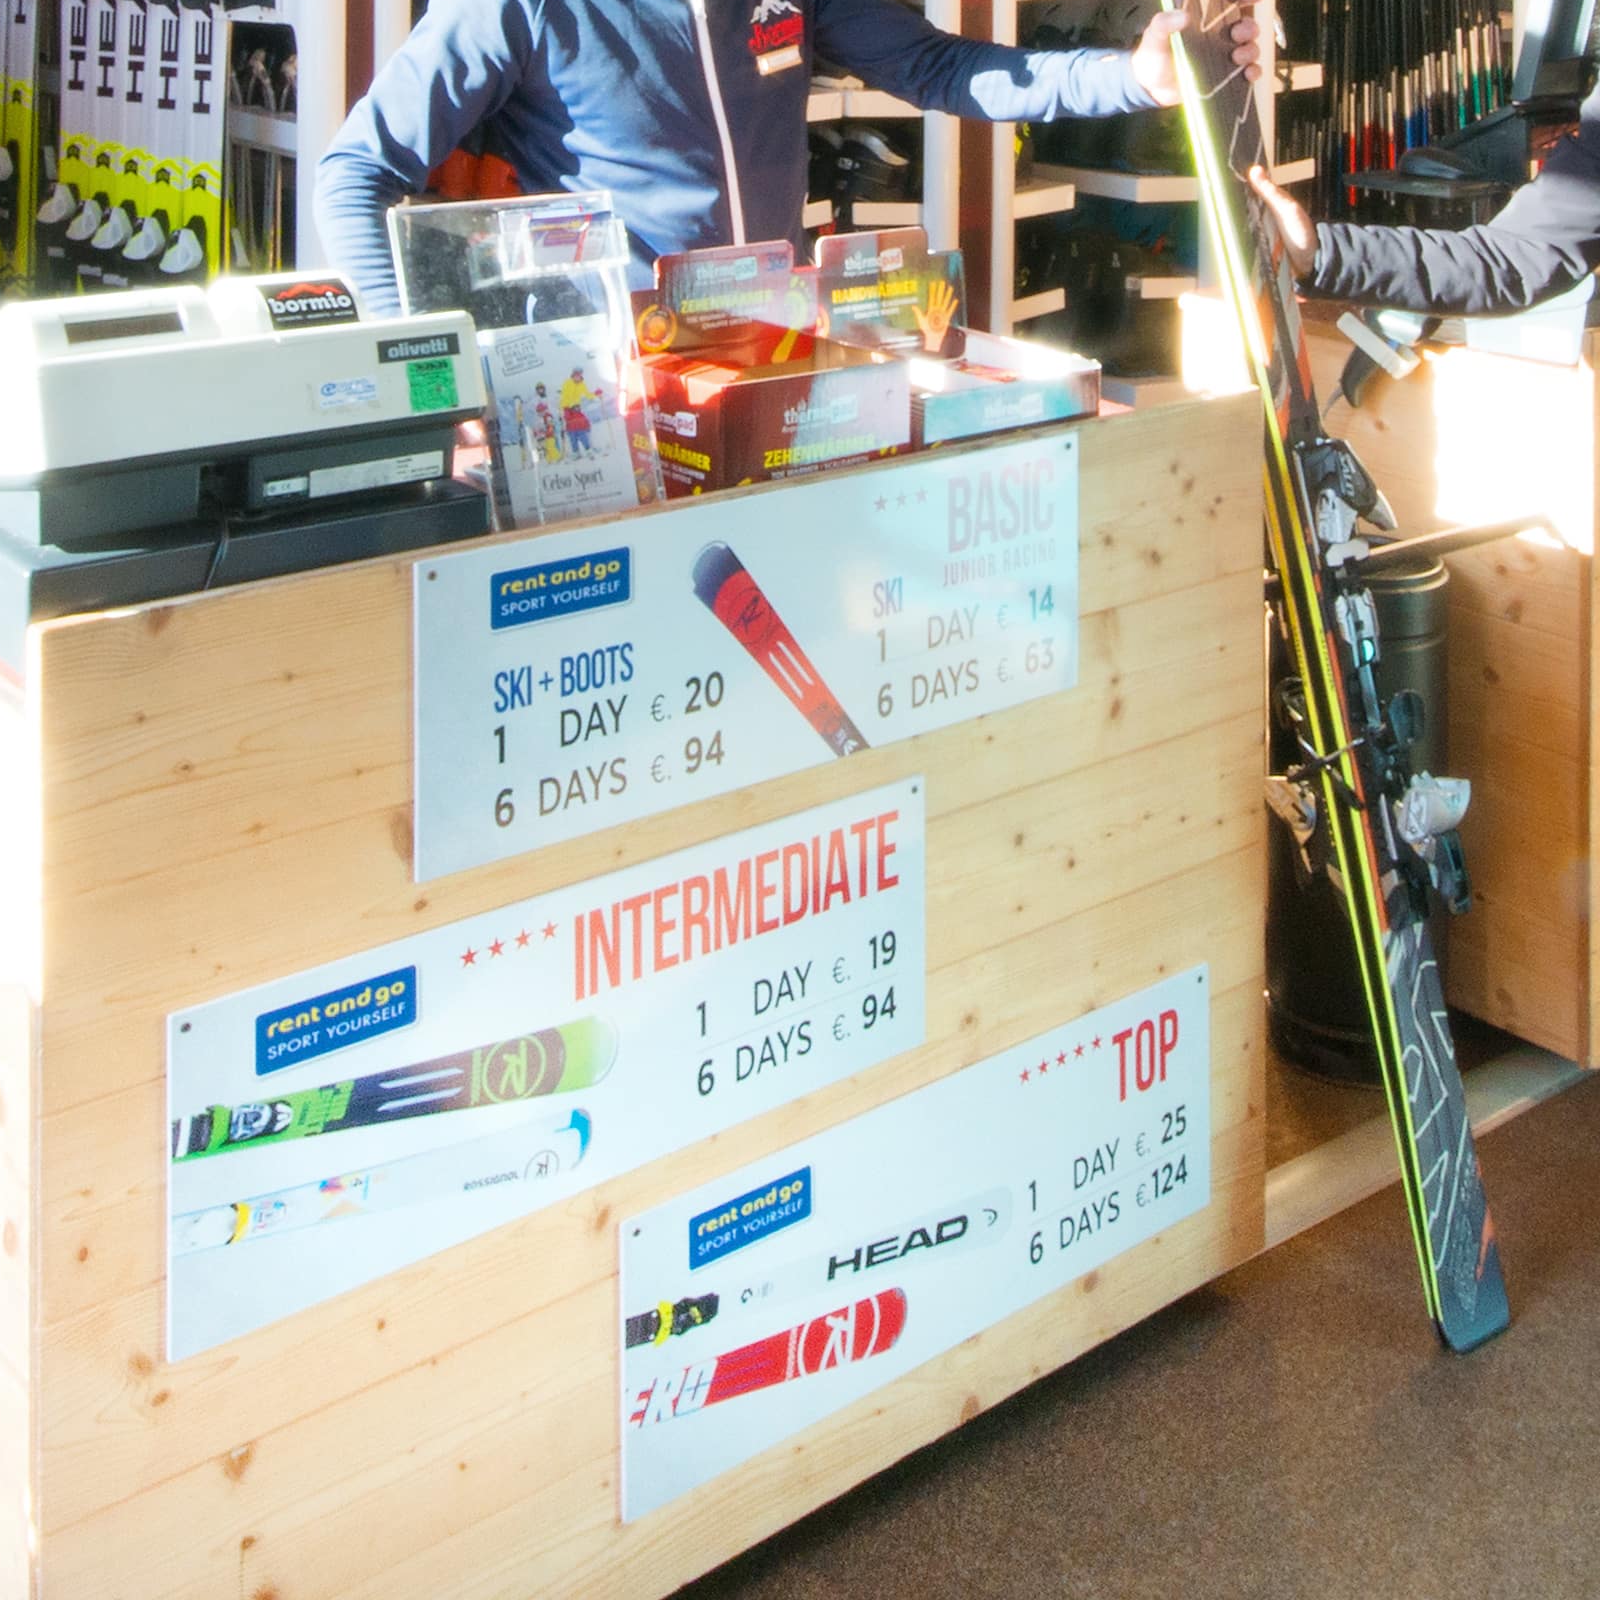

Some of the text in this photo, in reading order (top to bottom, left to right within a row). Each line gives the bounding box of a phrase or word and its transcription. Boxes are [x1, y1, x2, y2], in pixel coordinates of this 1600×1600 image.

[270, 291, 352, 315] bormio
[387, 337, 449, 360] olivetti
[574, 469, 604, 491] Sport
[947, 457, 1055, 554] BASIC
[500, 560, 621, 597] rent and go
[872, 575, 904, 619] SKI
[943, 538, 1056, 587] JUNIOR RACING
[500, 579, 622, 617] SPORT YOURSELF
[876, 628, 887, 663] 1
[926, 603, 981, 650] DAY
[1028, 584, 1055, 622] 14
[493, 641, 635, 714] SKI + BOOTS
[877, 682, 894, 719] 6
[911, 658, 981, 710] DAYS
[1024, 637, 1055, 675] 63
[493, 725, 506, 764] 1
[560, 694, 628, 748] DAY
[684, 670, 725, 715] 20
[494, 787, 515, 829] 6
[538, 756, 628, 817] DAYS
[684, 729, 725, 775] 94
[573, 808, 900, 1004] INTERMEDIATE
[266, 979, 407, 1039] rent and go
[696, 1000, 708, 1038] 1
[753, 960, 813, 1017] DAY
[868, 929, 897, 971] 19
[266, 1002, 407, 1061] SPORT YOURSELF
[697, 1058, 716, 1097] 6
[734, 1020, 813, 1083] DAYS
[862, 985, 897, 1031] 94
[1111, 1008, 1179, 1103] TOP
[462, 1169, 520, 1193] ROSSIGNOL
[1028, 1179, 1038, 1213] 1
[1072, 1137, 1121, 1191] DAY
[1160, 1103, 1188, 1145] 25
[696, 1178, 804, 1238] rent and go
[697, 1199, 805, 1258] SPORT YOURSELF
[1029, 1230, 1044, 1266] 6
[1058, 1190, 1121, 1250] DAYS
[1151, 1153, 1188, 1199] 124
[826, 1214, 969, 1283] HEAD
